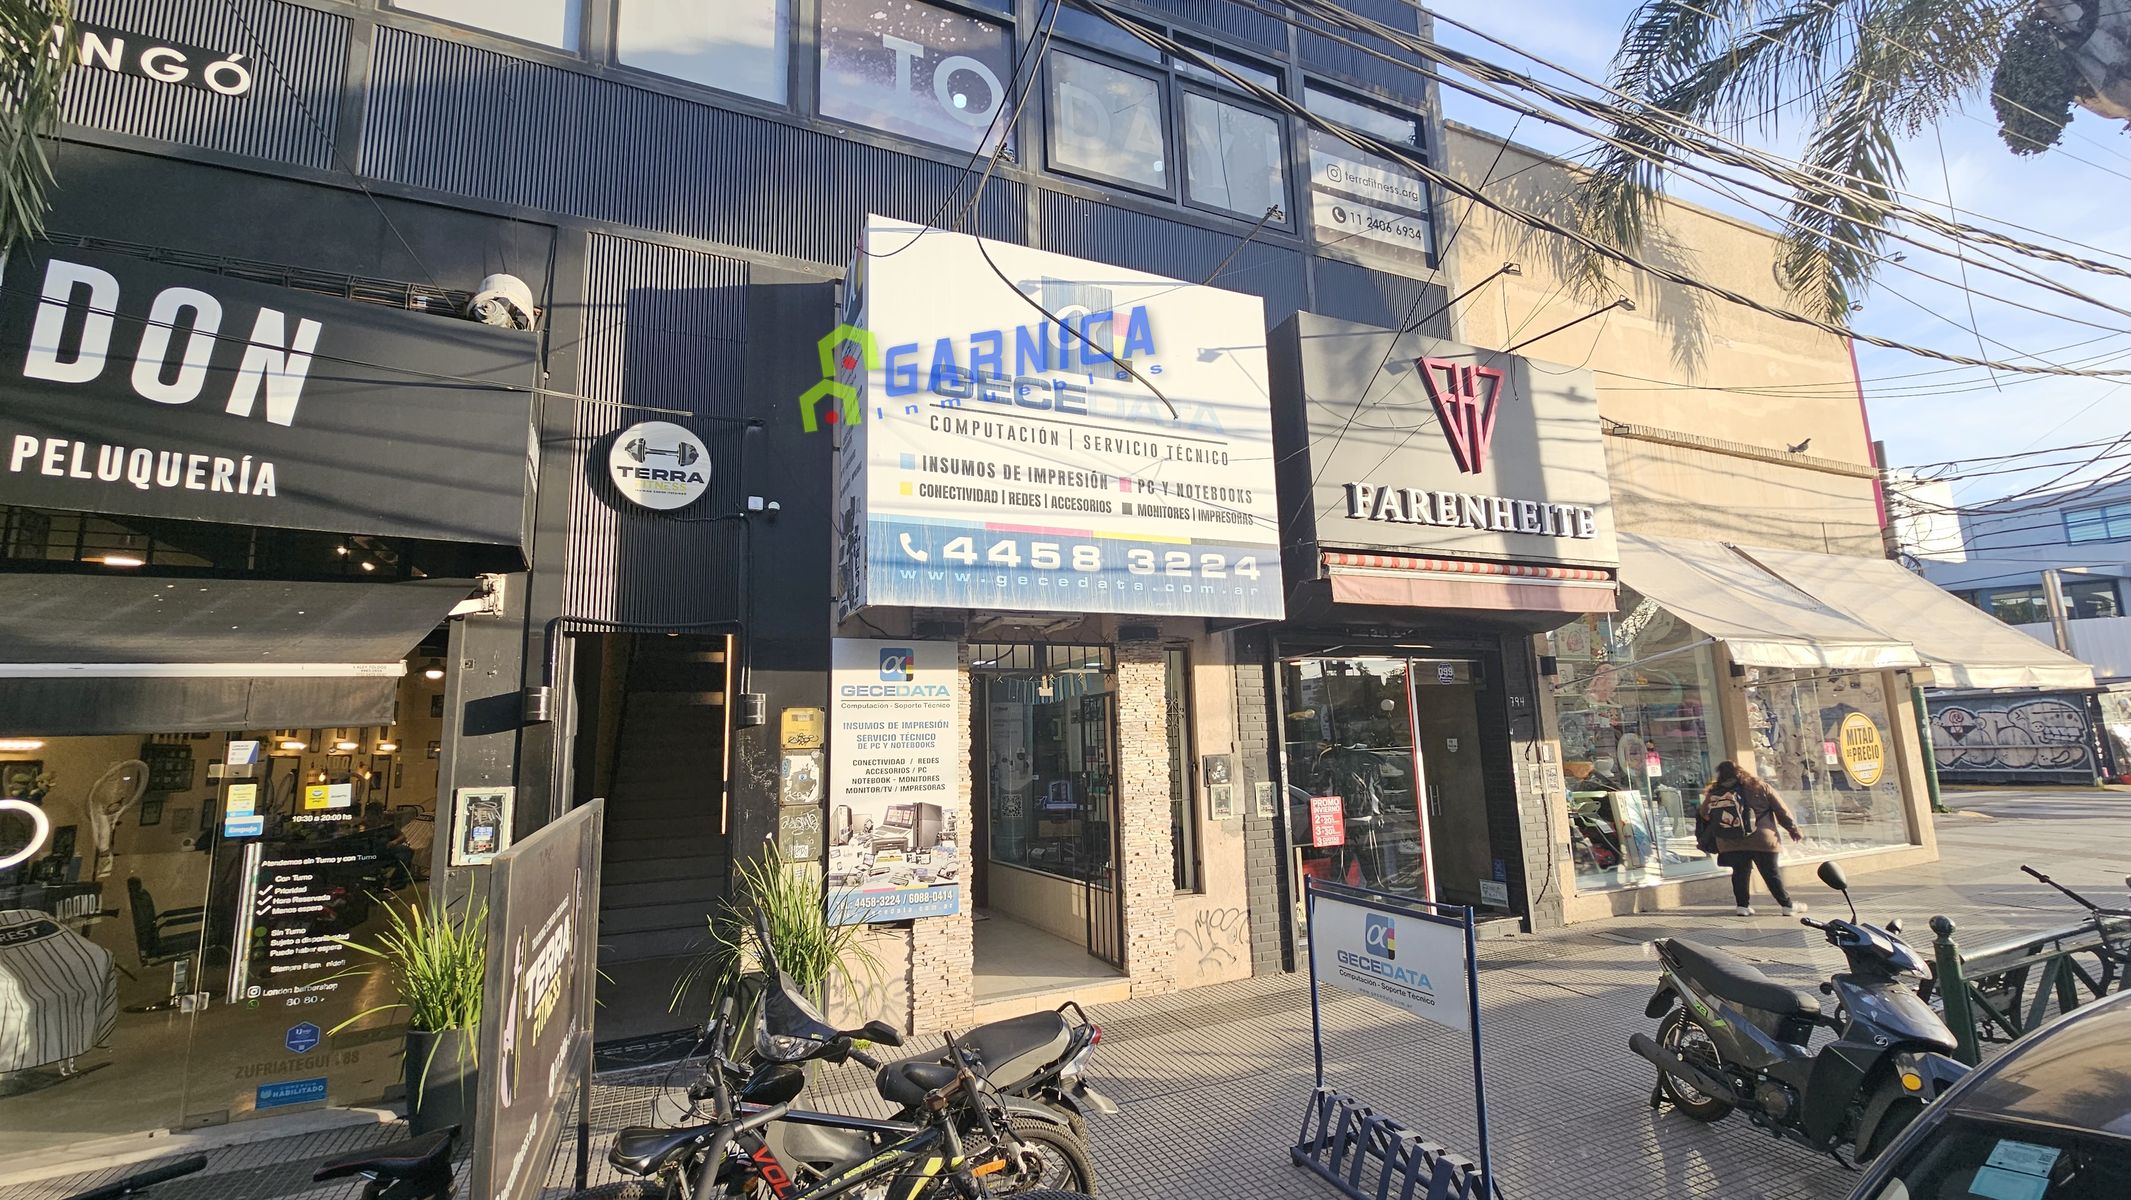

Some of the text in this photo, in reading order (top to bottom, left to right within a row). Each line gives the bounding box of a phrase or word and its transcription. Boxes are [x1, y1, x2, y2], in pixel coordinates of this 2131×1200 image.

[1345, 171, 1418, 202] terrafitness.org
[1350, 212, 1422, 240] 11 2406 6934
[23, 259, 322, 427] DON
[930, 414, 1229, 466] COMPUTACIÓN SERVICIO TÉCNICO
[9, 434, 277, 497] PELUQUERÍA
[617, 466, 705, 484] TERRA
[922, 455, 1252, 504] INSUMOS DE IMPRESIÓN PC Y NOTEBOOKS
[634, 480, 687, 492] FITNESS
[919, 483, 1254, 526] CONECTIVIDAD REDES ACCESORIOS MONITORES IMPRESORAS
[1342, 481, 1599, 539] FARENHEITE
[943, 536, 1261, 581] 4458 3224
[900, 568, 1259, 596] www.gecedata.com.ar
[840, 685, 951, 697] GECEDATA
[894, 702, 922, 710] Soporte
[1509, 696, 1525, 707] 794
[843, 719, 949, 730] INSUMOS DE IMPRESIÓN
[857, 732, 936, 742] SERVICIO TÉCNICO
[1846, 727, 1874, 747] MITAD
[891, 741, 935, 749] NOTEBOOKS
[1852, 745, 1880, 762] PRECIO
[852, 758, 906, 767] CONECTIVIDAD
[865, 767, 910, 775] ACCESORIOS
[852, 775, 940, 785] NOTEBOOK MONITORES
[845, 784, 946, 794] MONITOR/TV IMPRESORAS
[292, 815, 313, 823] 10:30
[321, 814, 341, 822] 20:00
[261, 859, 302, 867] Atendemos
[274, 886, 307, 895] Prioridad
[292, 894, 331, 903] Reservada
[854, 894, 901, 909] 4458-3224
[908, 890, 953, 904] 6088-0414
[272, 905, 323, 915] Menos espera
[271, 929, 284, 937] Sin
[270, 939, 295, 948] Sujeto
[270, 948, 294, 957] Puede
[317, 944, 343, 954] espera
[271, 964, 302, 973] Siempre
[525, 914, 571, 1019] TERRA
[1337, 949, 1433, 990] GECEDATA
[262, 987, 293, 997] London
[1339, 969, 1436, 1006] Computación Soporte Técnico
[533, 967, 562, 1047] FITNESS
[235, 1055, 329, 1079] ZUFRIATEGUI
[272, 1084, 324, 1098] HABILITADO
